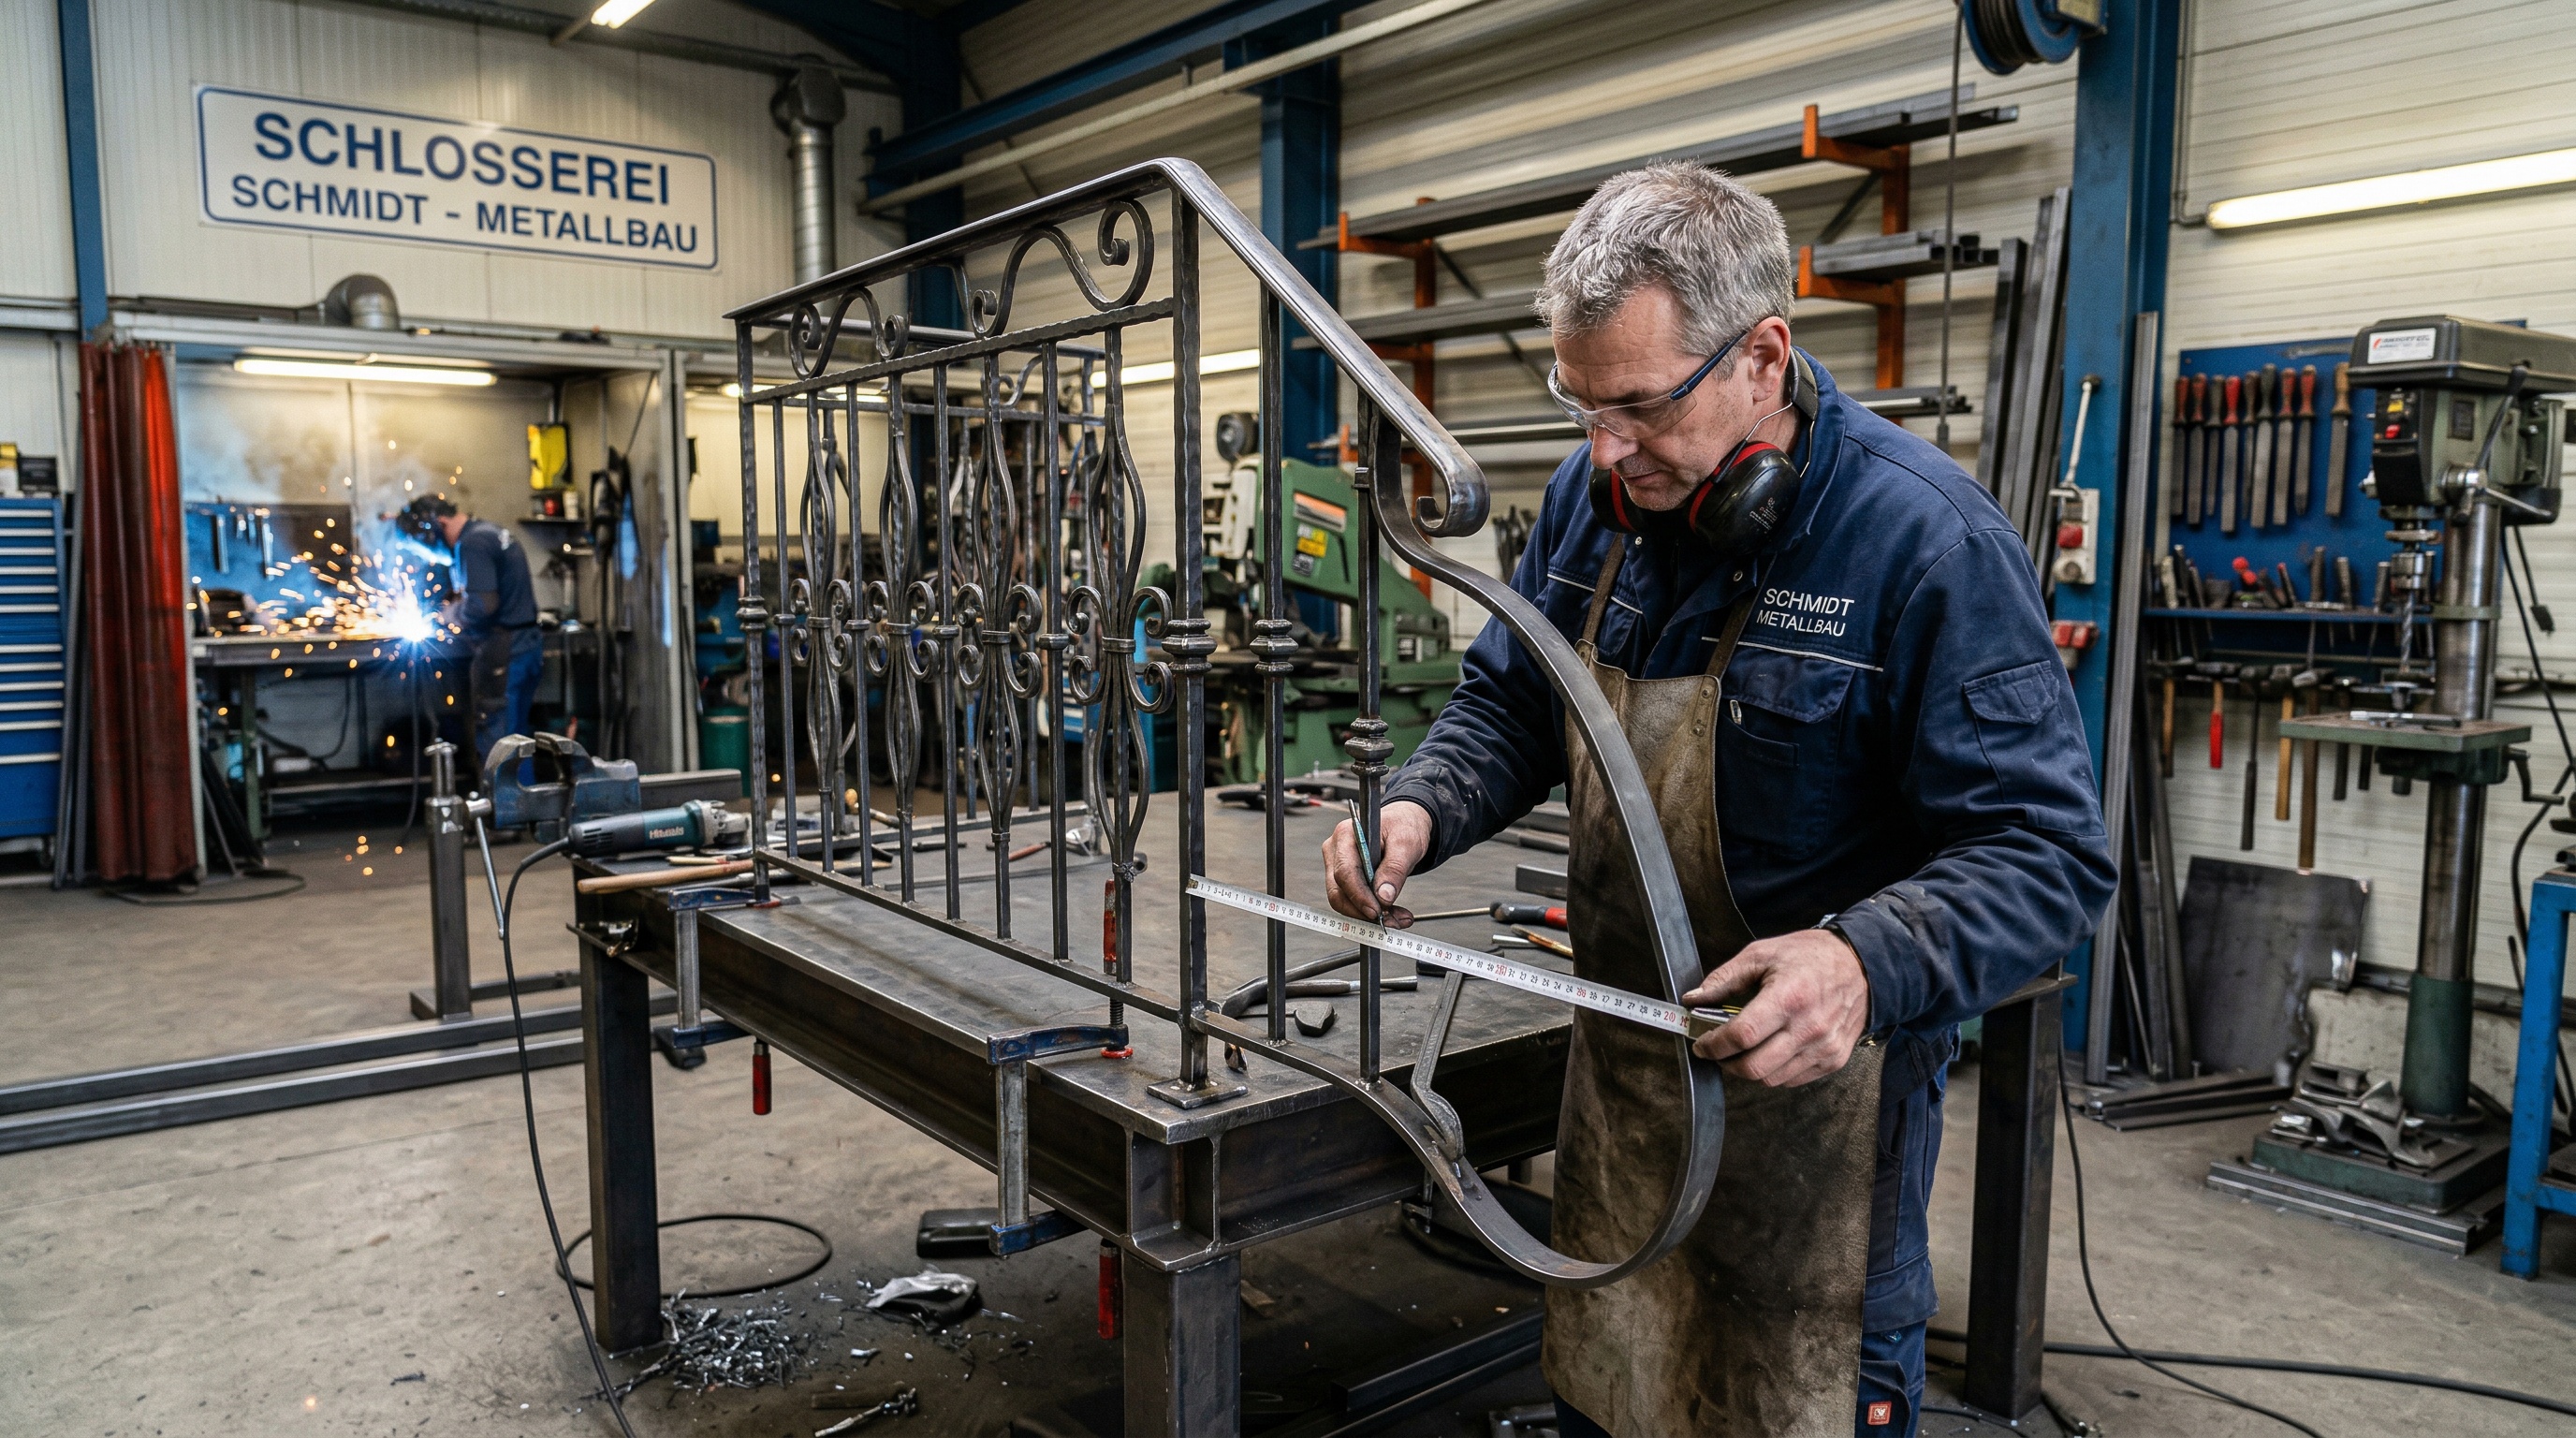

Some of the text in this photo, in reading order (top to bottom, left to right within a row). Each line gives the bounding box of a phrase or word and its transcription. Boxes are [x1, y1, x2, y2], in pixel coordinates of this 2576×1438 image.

[254, 112, 669, 206] SCHLOSSEREI
[232, 175, 429, 225] SCHMIDT
[476, 202, 697, 254] METALLBAU
[1756, 588, 1855, 638] SCHMIDT METALLBAU
